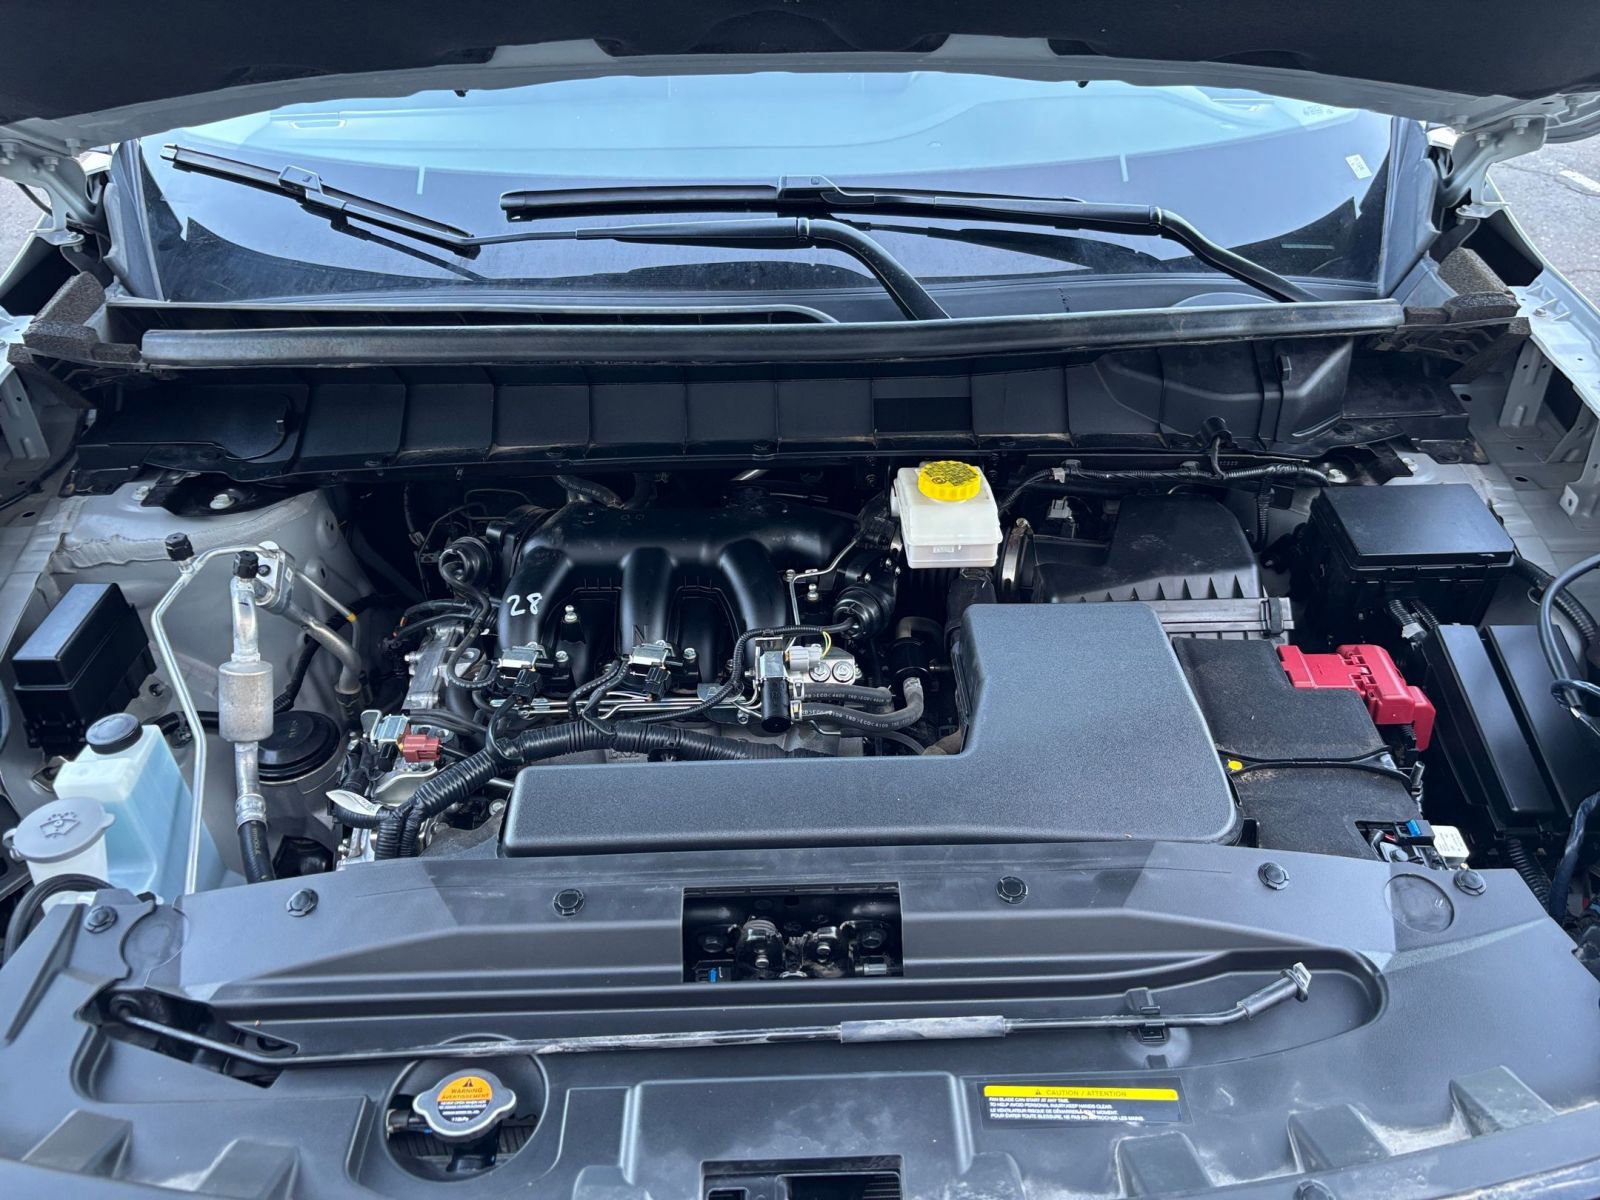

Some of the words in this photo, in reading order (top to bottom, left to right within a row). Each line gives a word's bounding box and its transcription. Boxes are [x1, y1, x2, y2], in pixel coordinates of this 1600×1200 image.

[506, 592, 543, 617] 28
[1046, 1089, 1079, 1097] CAUTION
[1087, 1090, 1127, 1098] ATTENTION
